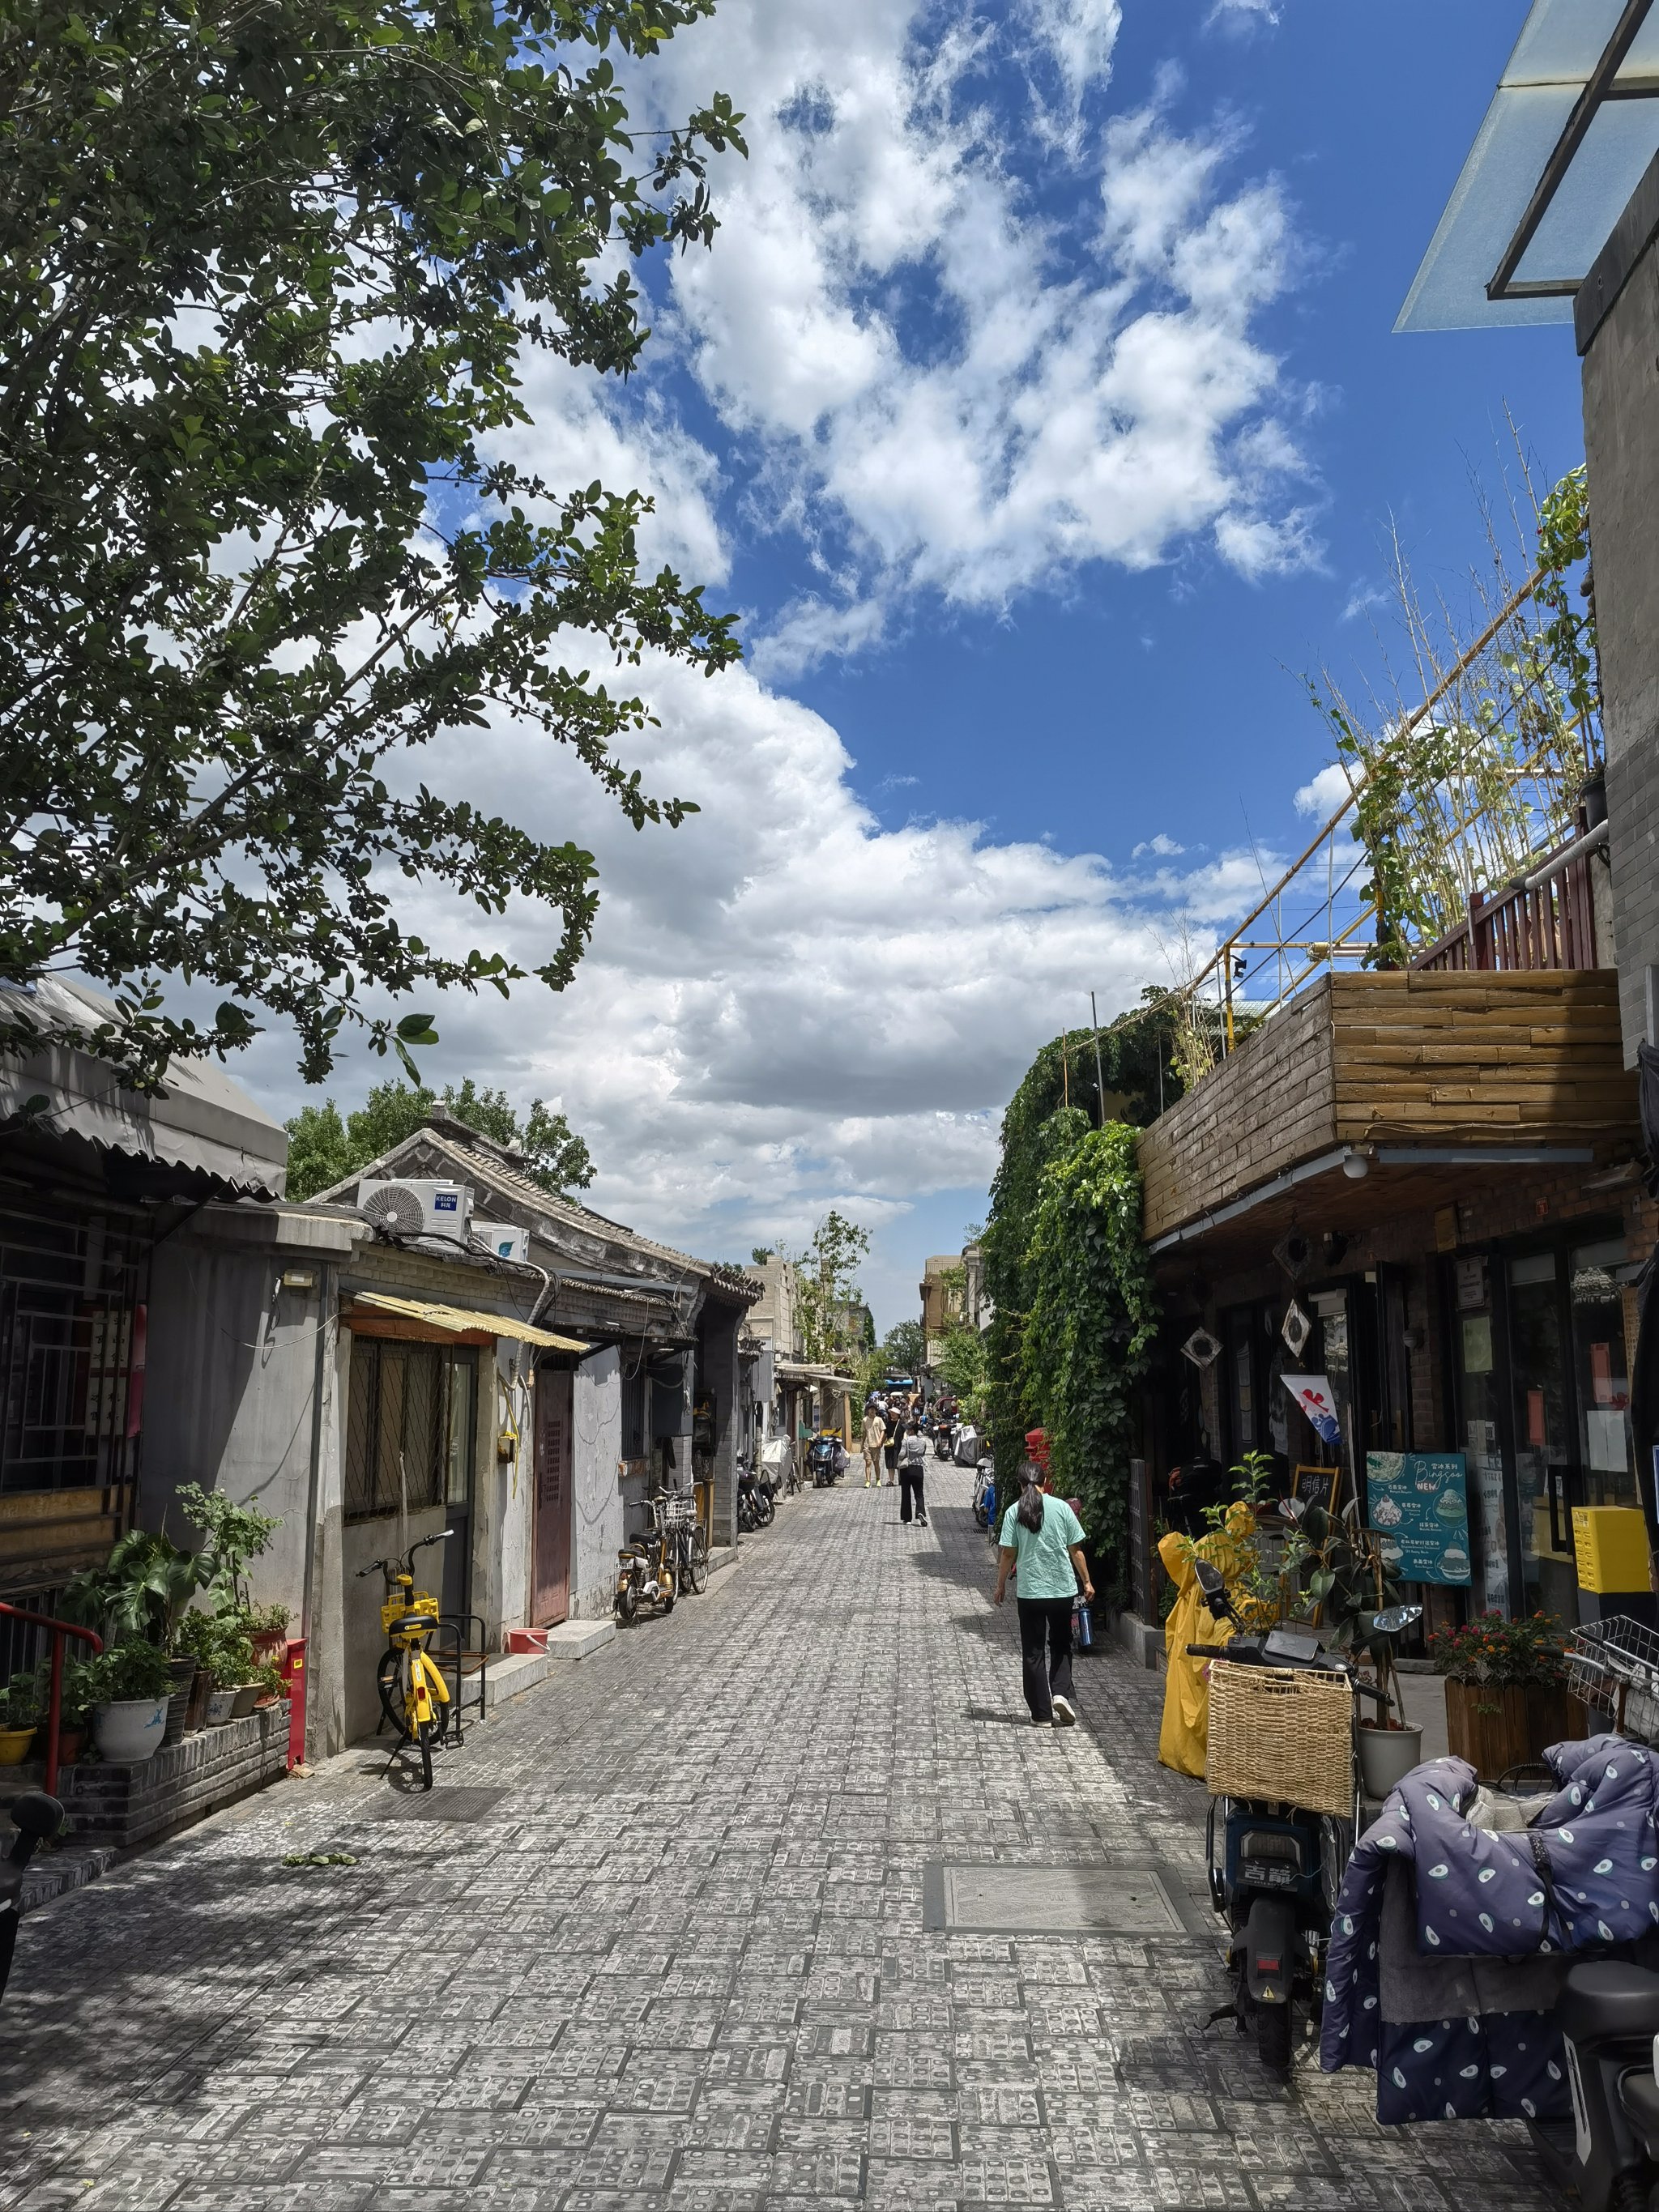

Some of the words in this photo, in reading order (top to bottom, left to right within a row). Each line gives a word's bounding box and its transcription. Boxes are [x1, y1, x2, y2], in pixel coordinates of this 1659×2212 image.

[1302, 1475, 1329, 1496] 明信片
[1414, 1460, 1463, 1490] Bingsoo
[1417, 1482, 1436, 1491] NEW
